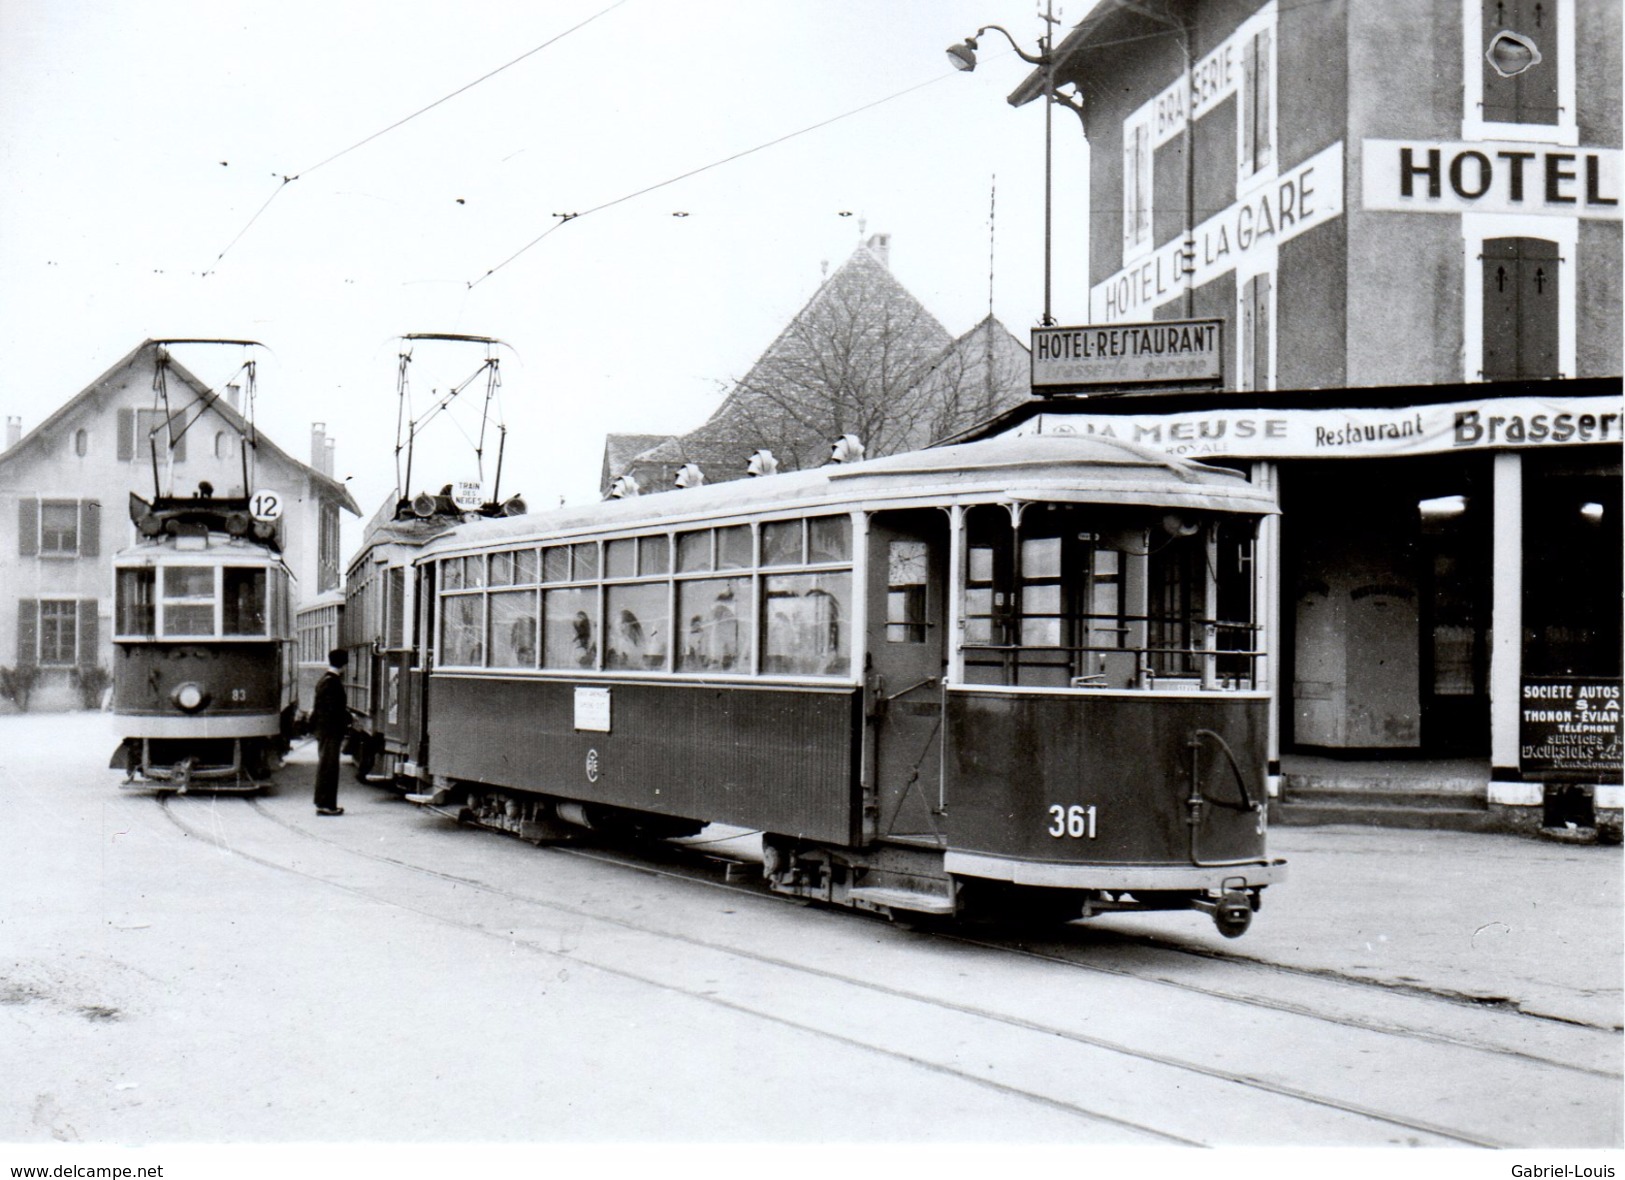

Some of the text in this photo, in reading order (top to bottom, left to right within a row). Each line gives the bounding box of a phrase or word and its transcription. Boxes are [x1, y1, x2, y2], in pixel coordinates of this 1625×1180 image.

[1159, 45, 1232, 135] BRASERIE
[1399, 148, 1619, 206] HOTEL
[1106, 256, 1167, 322] HOTEL
[1205, 224, 1230, 266] LA
[1237, 167, 1315, 252] GARE
[1133, 419, 1288, 443] MEUSE
[1315, 413, 1424, 448] Restaurant
[459, 482, 481, 490] TRAIN
[255, 495, 277, 517] 12
[456, 496, 482, 505] NEIGES
[232, 689, 246, 701] 83
[1580, 686, 1620, 698] AUTOS
[1048, 804, 1098, 839] 361
